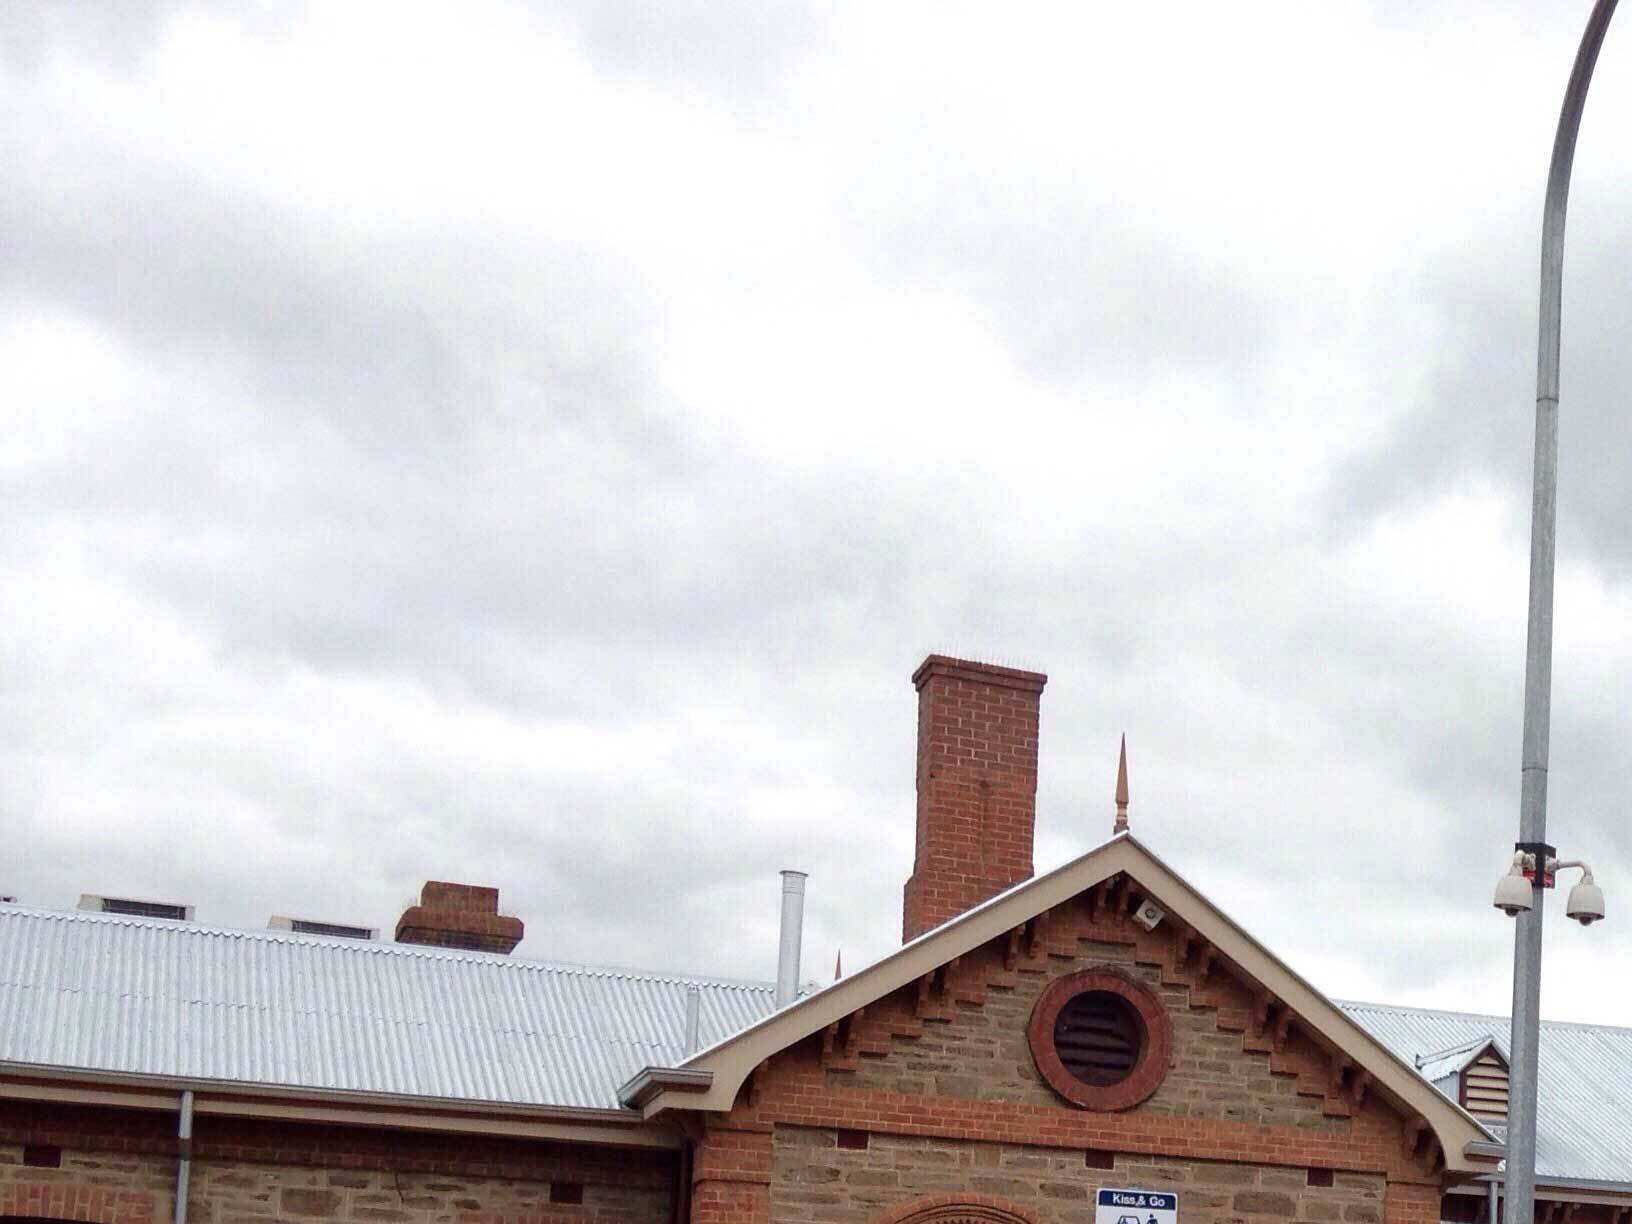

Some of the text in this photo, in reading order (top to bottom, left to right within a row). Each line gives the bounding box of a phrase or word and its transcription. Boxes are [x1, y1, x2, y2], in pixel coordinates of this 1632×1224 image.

[1112, 1193, 1165, 1207] Kiss & Go
